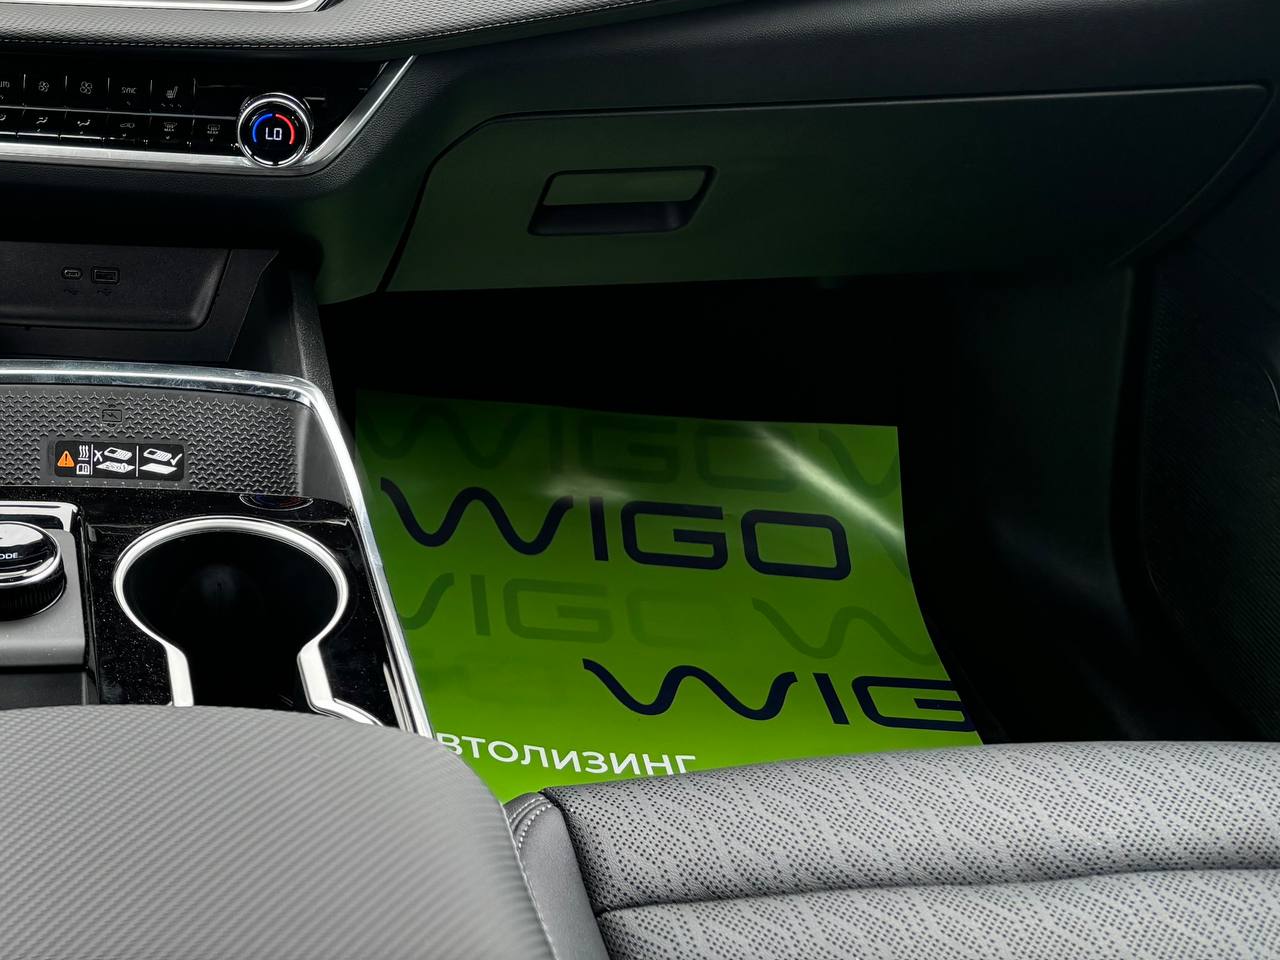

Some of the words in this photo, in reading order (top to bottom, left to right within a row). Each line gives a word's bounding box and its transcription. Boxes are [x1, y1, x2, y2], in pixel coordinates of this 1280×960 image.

[265, 127, 282, 141] LO
[380, 476, 852, 581] WIGO
[582, 657, 978, 733] WIG
[435, 732, 696, 776] ВТОЛИЗИНГ
